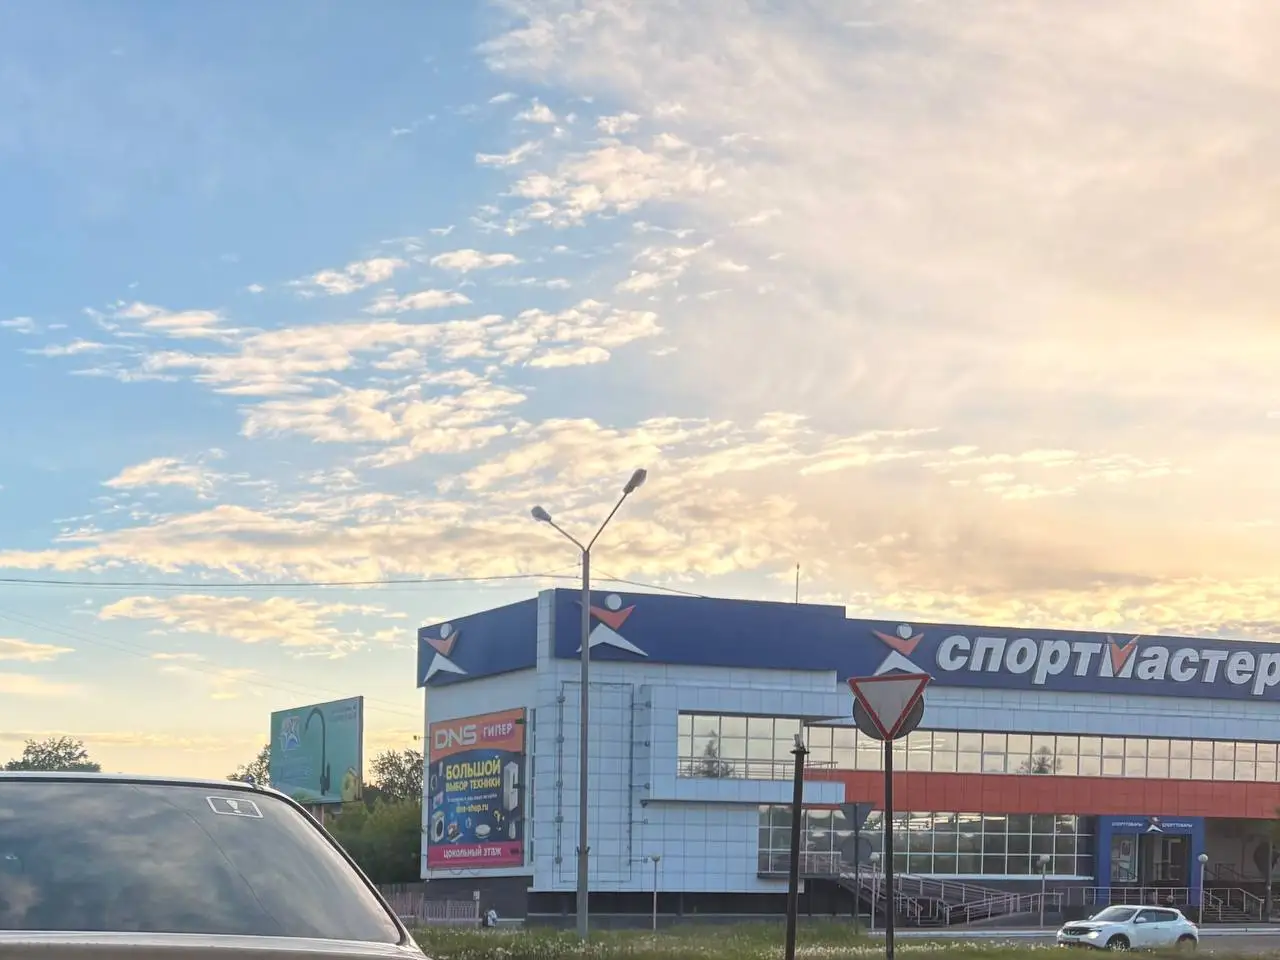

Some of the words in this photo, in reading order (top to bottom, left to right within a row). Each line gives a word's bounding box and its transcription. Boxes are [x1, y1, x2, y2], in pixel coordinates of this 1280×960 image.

[434, 724, 477, 750] DNS
[483, 722, 513, 738] ГИПЕР
[446, 757, 500, 781] БОЛЬШОЙ
